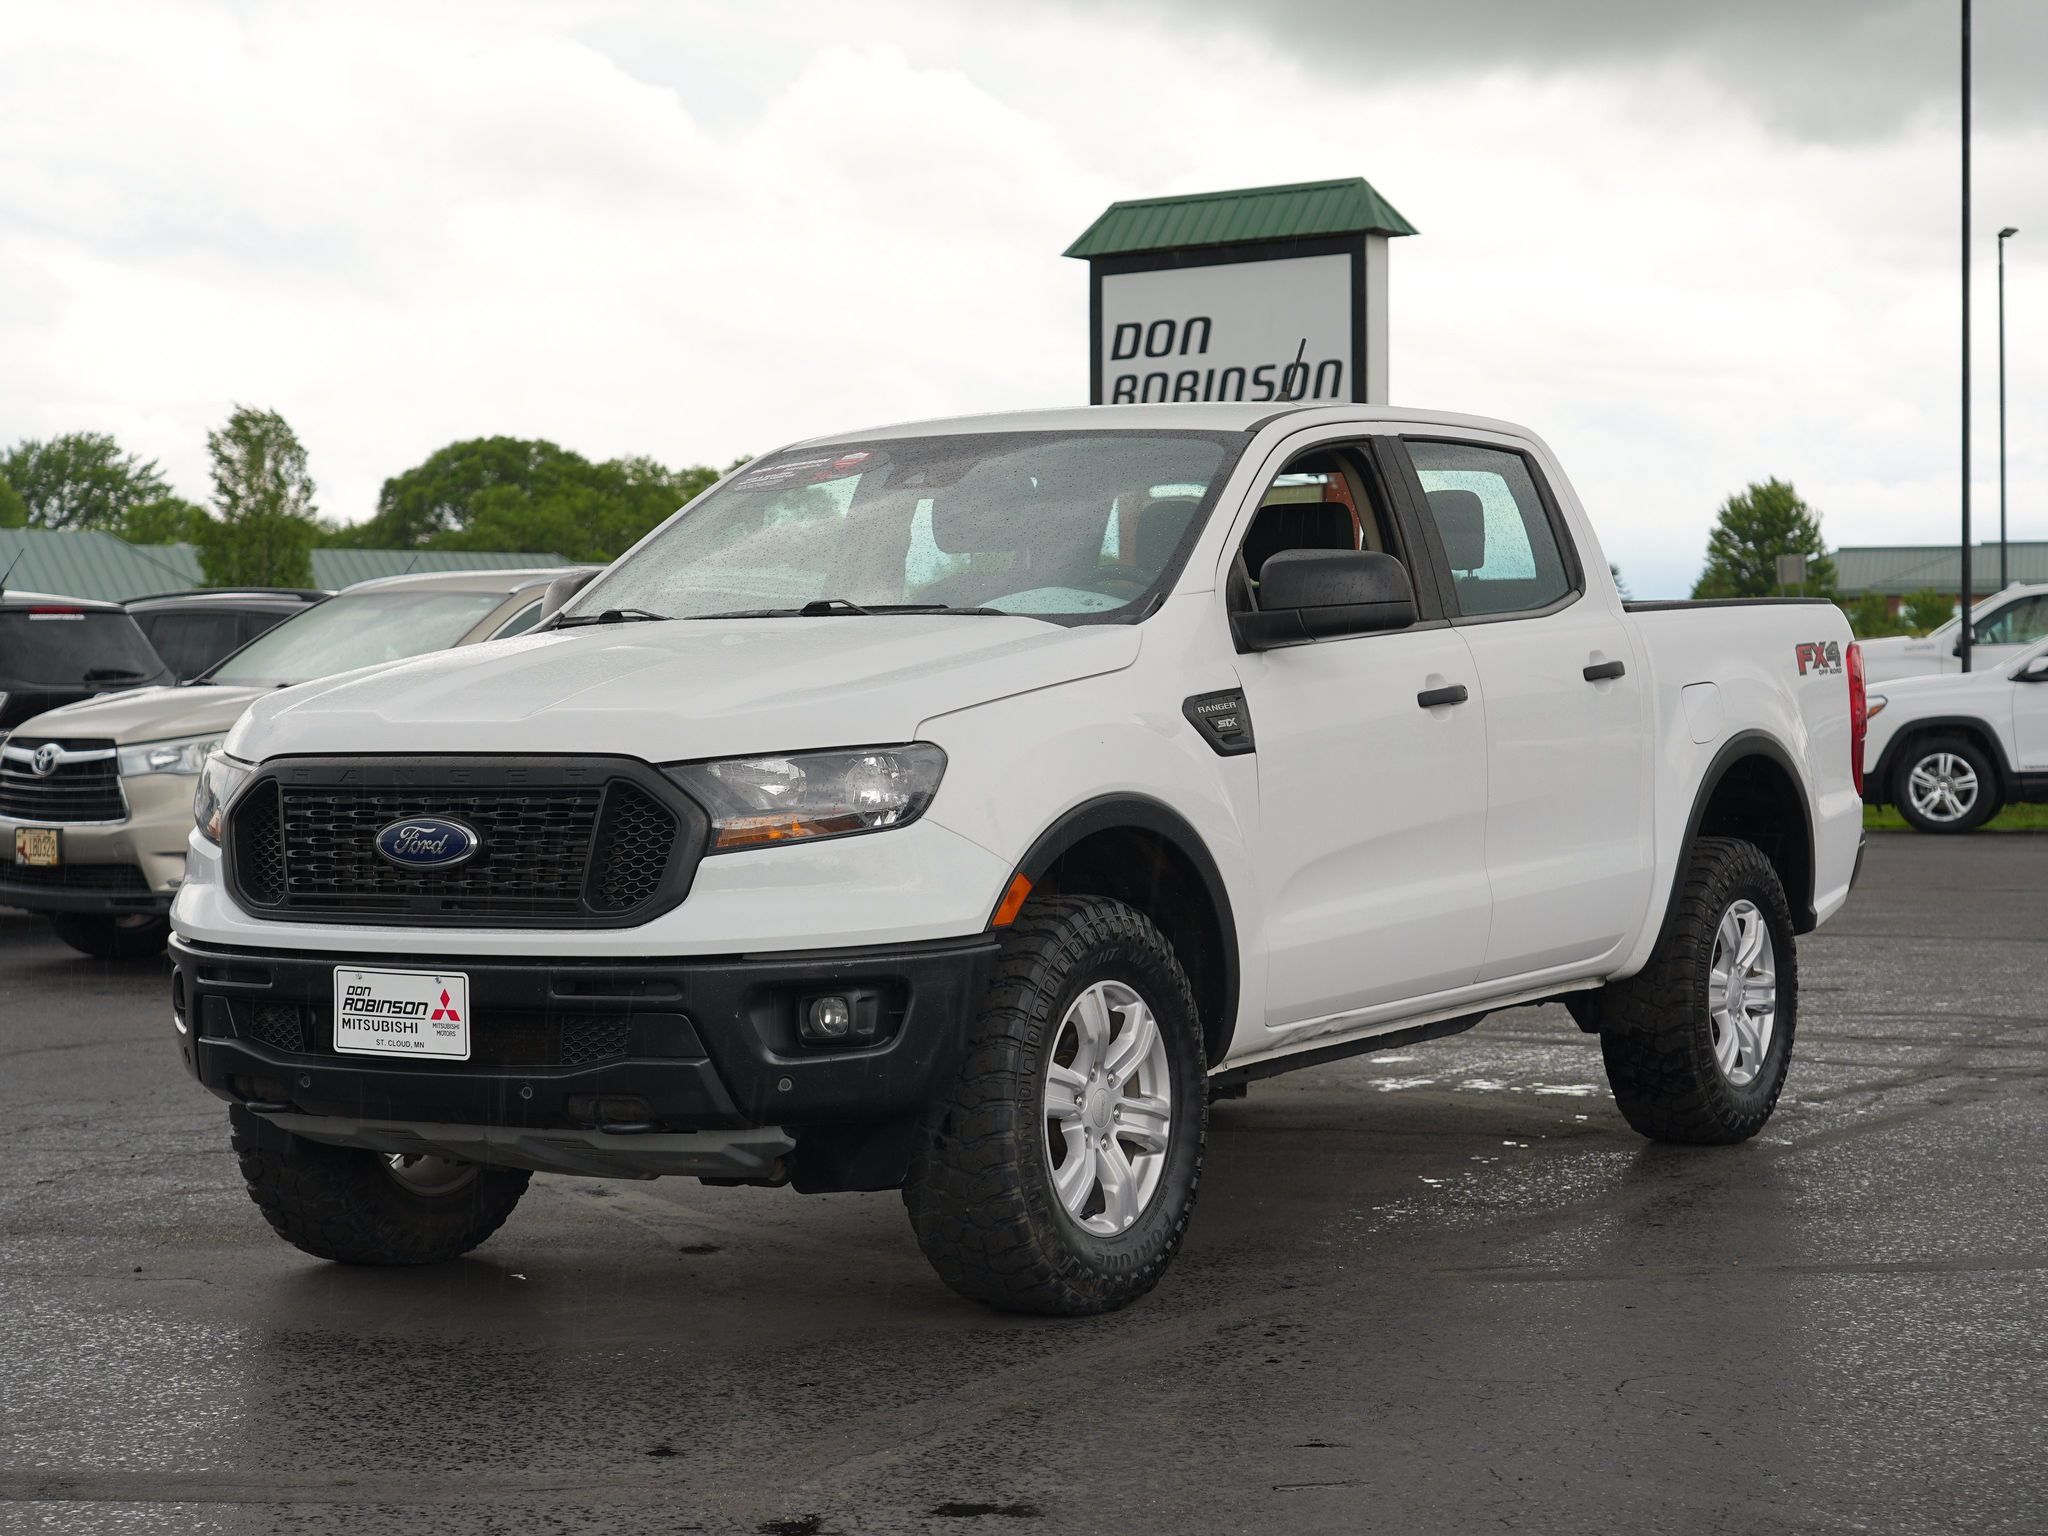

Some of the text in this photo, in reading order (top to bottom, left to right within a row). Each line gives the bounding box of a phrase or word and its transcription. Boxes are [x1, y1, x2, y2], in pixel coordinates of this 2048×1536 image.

[1110, 316, 1212, 361] DON
[1112, 359, 1343, 404] ROBINSON
[1795, 640, 1842, 676] FX4
[1198, 702, 1236, 713] RANGER
[1218, 718, 1237, 728] STX
[393, 826, 449, 854] Ford
[346, 985, 371, 996] DON
[343, 998, 428, 1015] ROBINSON
[342, 1018, 418, 1033] MITSUBISHI
[432, 1022, 460, 1030] MITSUBISHI
[388, 1040, 413, 1049] CLOUD,
